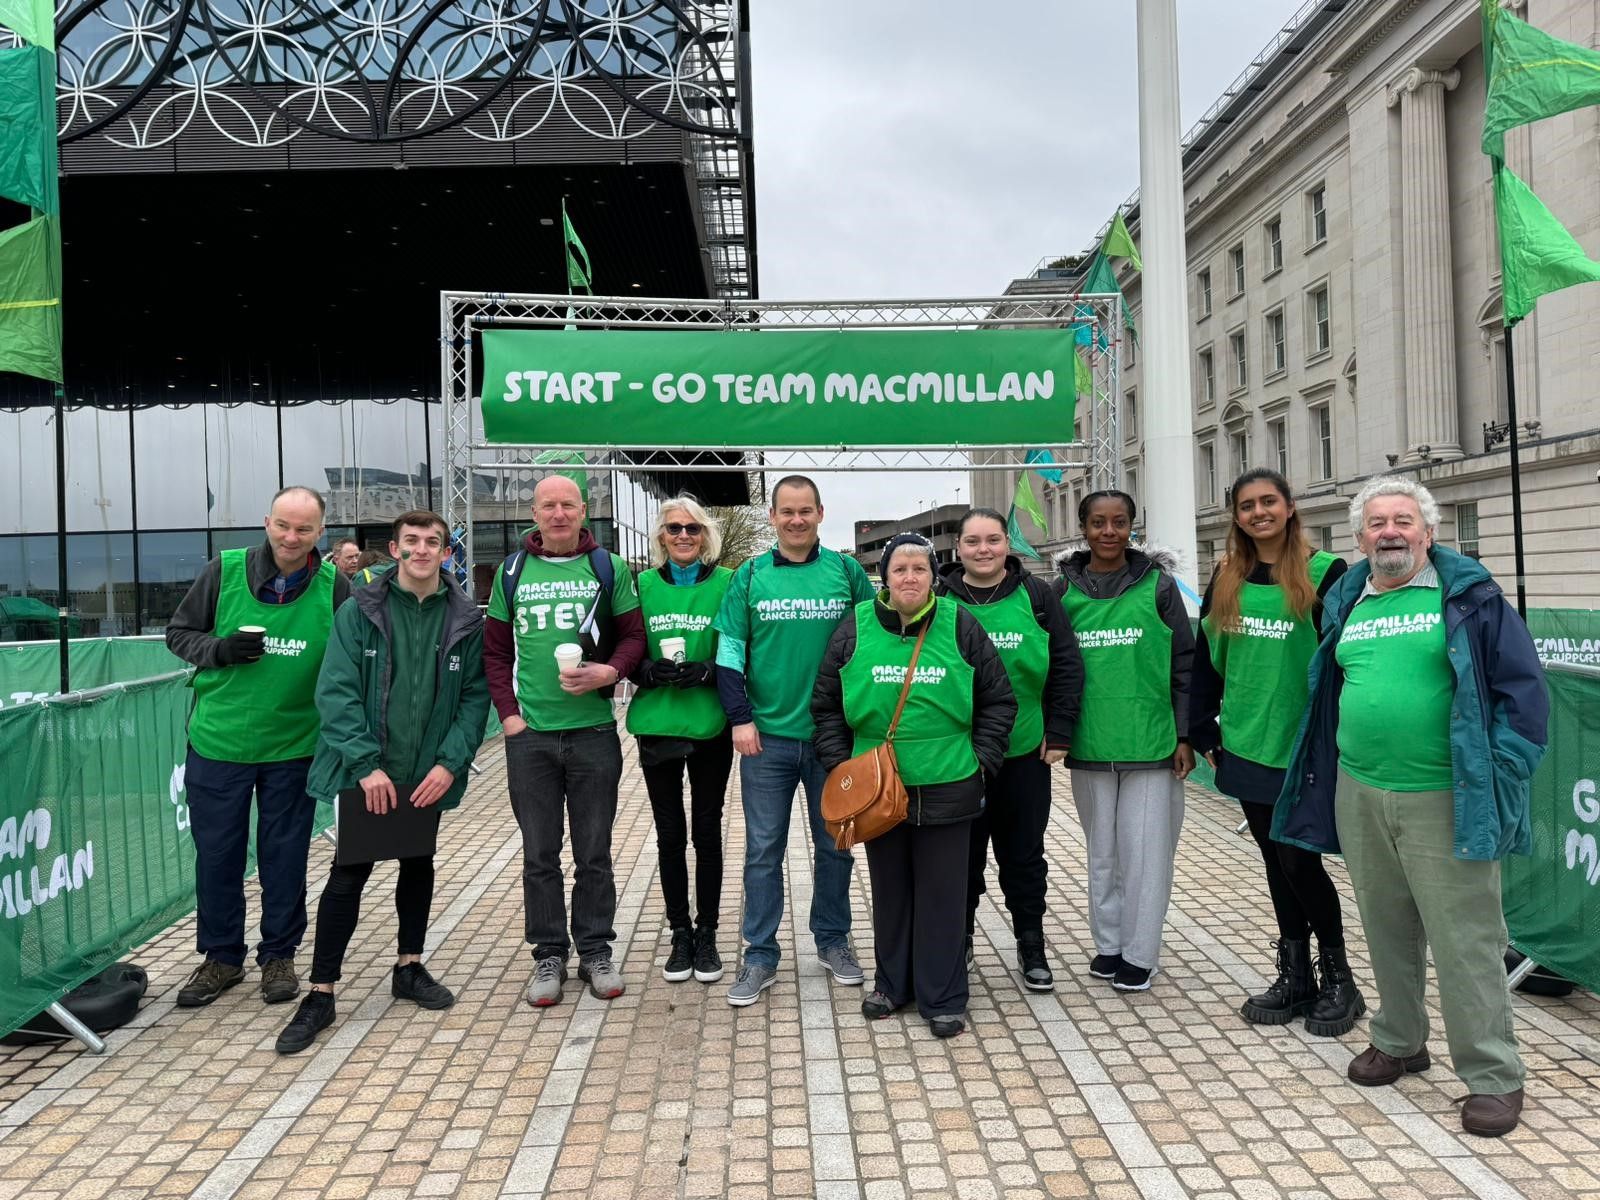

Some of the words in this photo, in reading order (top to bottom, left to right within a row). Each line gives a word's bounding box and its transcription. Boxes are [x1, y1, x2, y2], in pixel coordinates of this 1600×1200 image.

[503, 370, 621, 404] START
[652, 373, 706, 403] GO
[712, 372, 816, 405] TEAM
[824, 370, 1055, 405] MACMILLAN
[518, 592, 557, 602] CANCER
[757, 598, 846, 612] MACMILLAN
[649, 613, 711, 626] MACMILLAN
[760, 611, 797, 621] CANCER
[800, 610, 842, 620] SUPPORT
[675, 622, 706, 631] SUPPORT
[1342, 612, 1441, 635] MACMILLAN
[1074, 628, 1143, 641] MACMILLAN
[1222, 625, 1247, 634] CNCER
[1248, 628, 1287, 640] SUPPORT
[1340, 630, 1377, 643] CANCER
[1379, 623, 1433, 637] SUPPORT
[1102, 638, 1138, 646] SUPPORT
[872, 665, 946, 677] MACMLLAN
[0, 840, 94, 919] ILLAN
